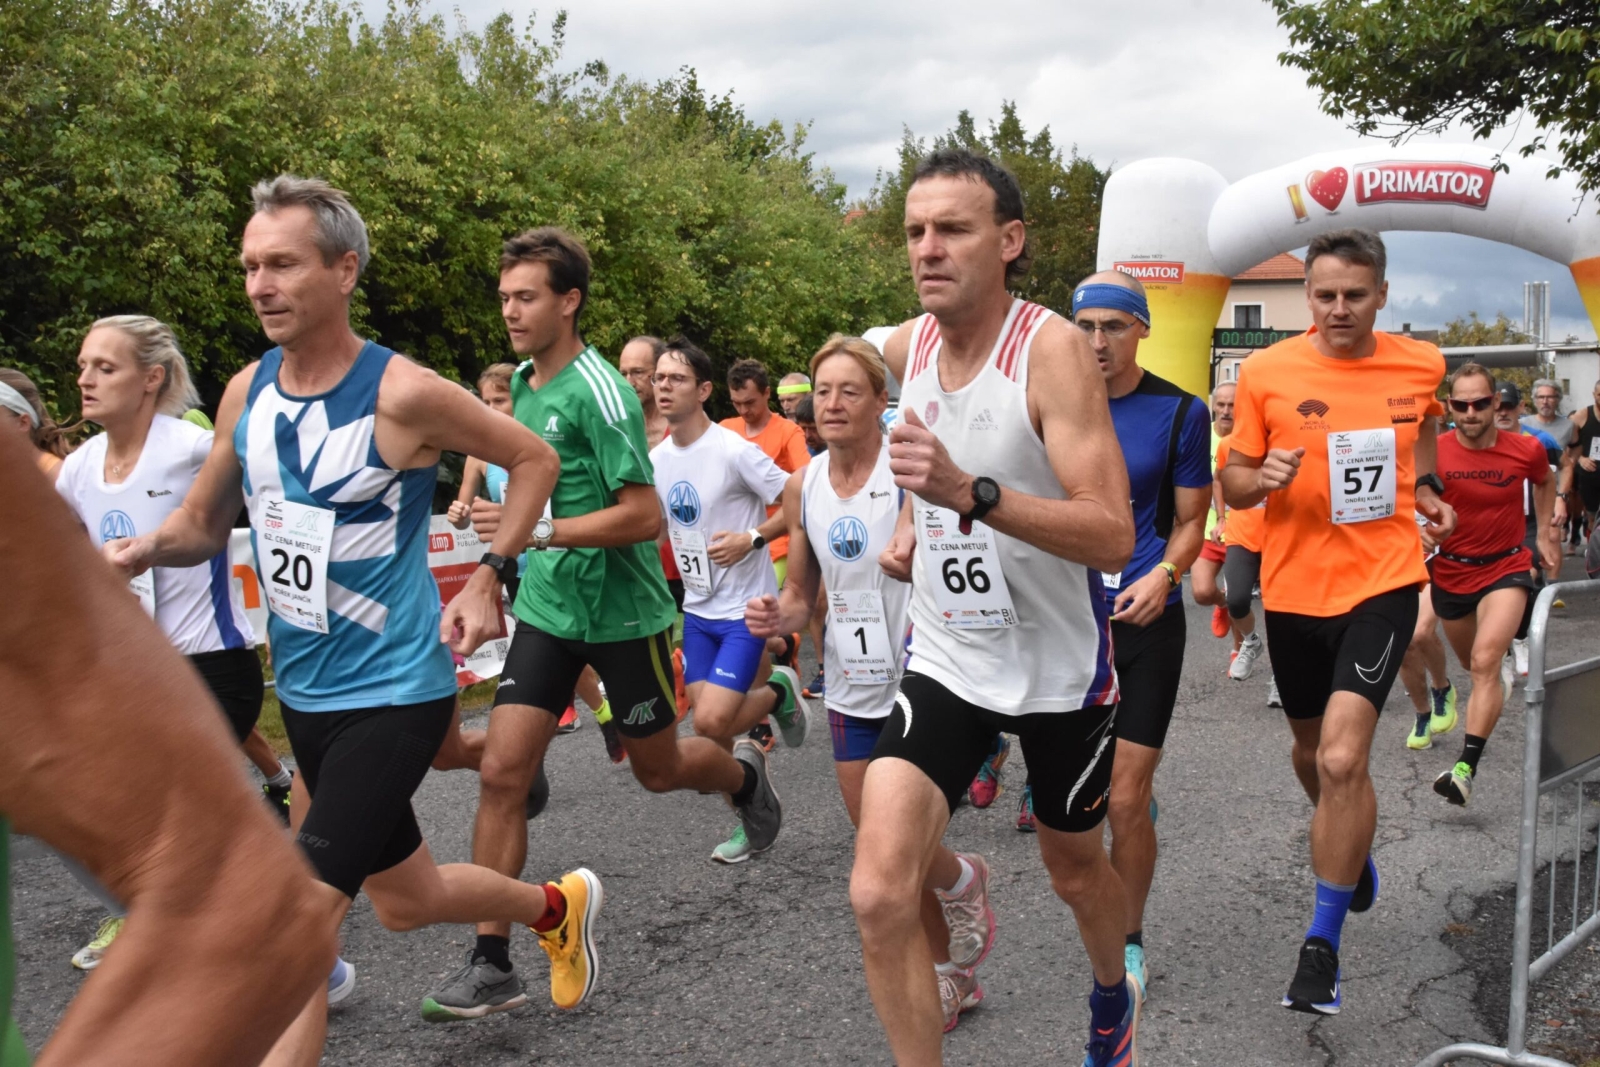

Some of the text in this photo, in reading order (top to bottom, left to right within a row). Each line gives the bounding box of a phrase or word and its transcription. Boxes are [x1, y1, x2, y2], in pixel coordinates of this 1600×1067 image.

[1336, 448, 1353, 456] CUP
[1365, 455, 1389, 463] METUJE
[1344, 465, 1383, 495] 57
[1445, 469, 1504, 481] saucony
[1366, 494, 1383, 502] KUBÍK
[456, 532, 477, 540] DIGITAL
[927, 529, 945, 538] CUP
[264, 533, 322, 554] 62. CENA METUJE
[432, 534, 449, 552] dmp
[941, 543, 960, 551] CENA
[961, 542, 989, 552] METUJE
[271, 548, 313, 592] 20
[680, 554, 701, 576] 31
[942, 557, 991, 594] 66
[860, 616, 881, 624] METUJE
[854, 627, 867, 655] 1
